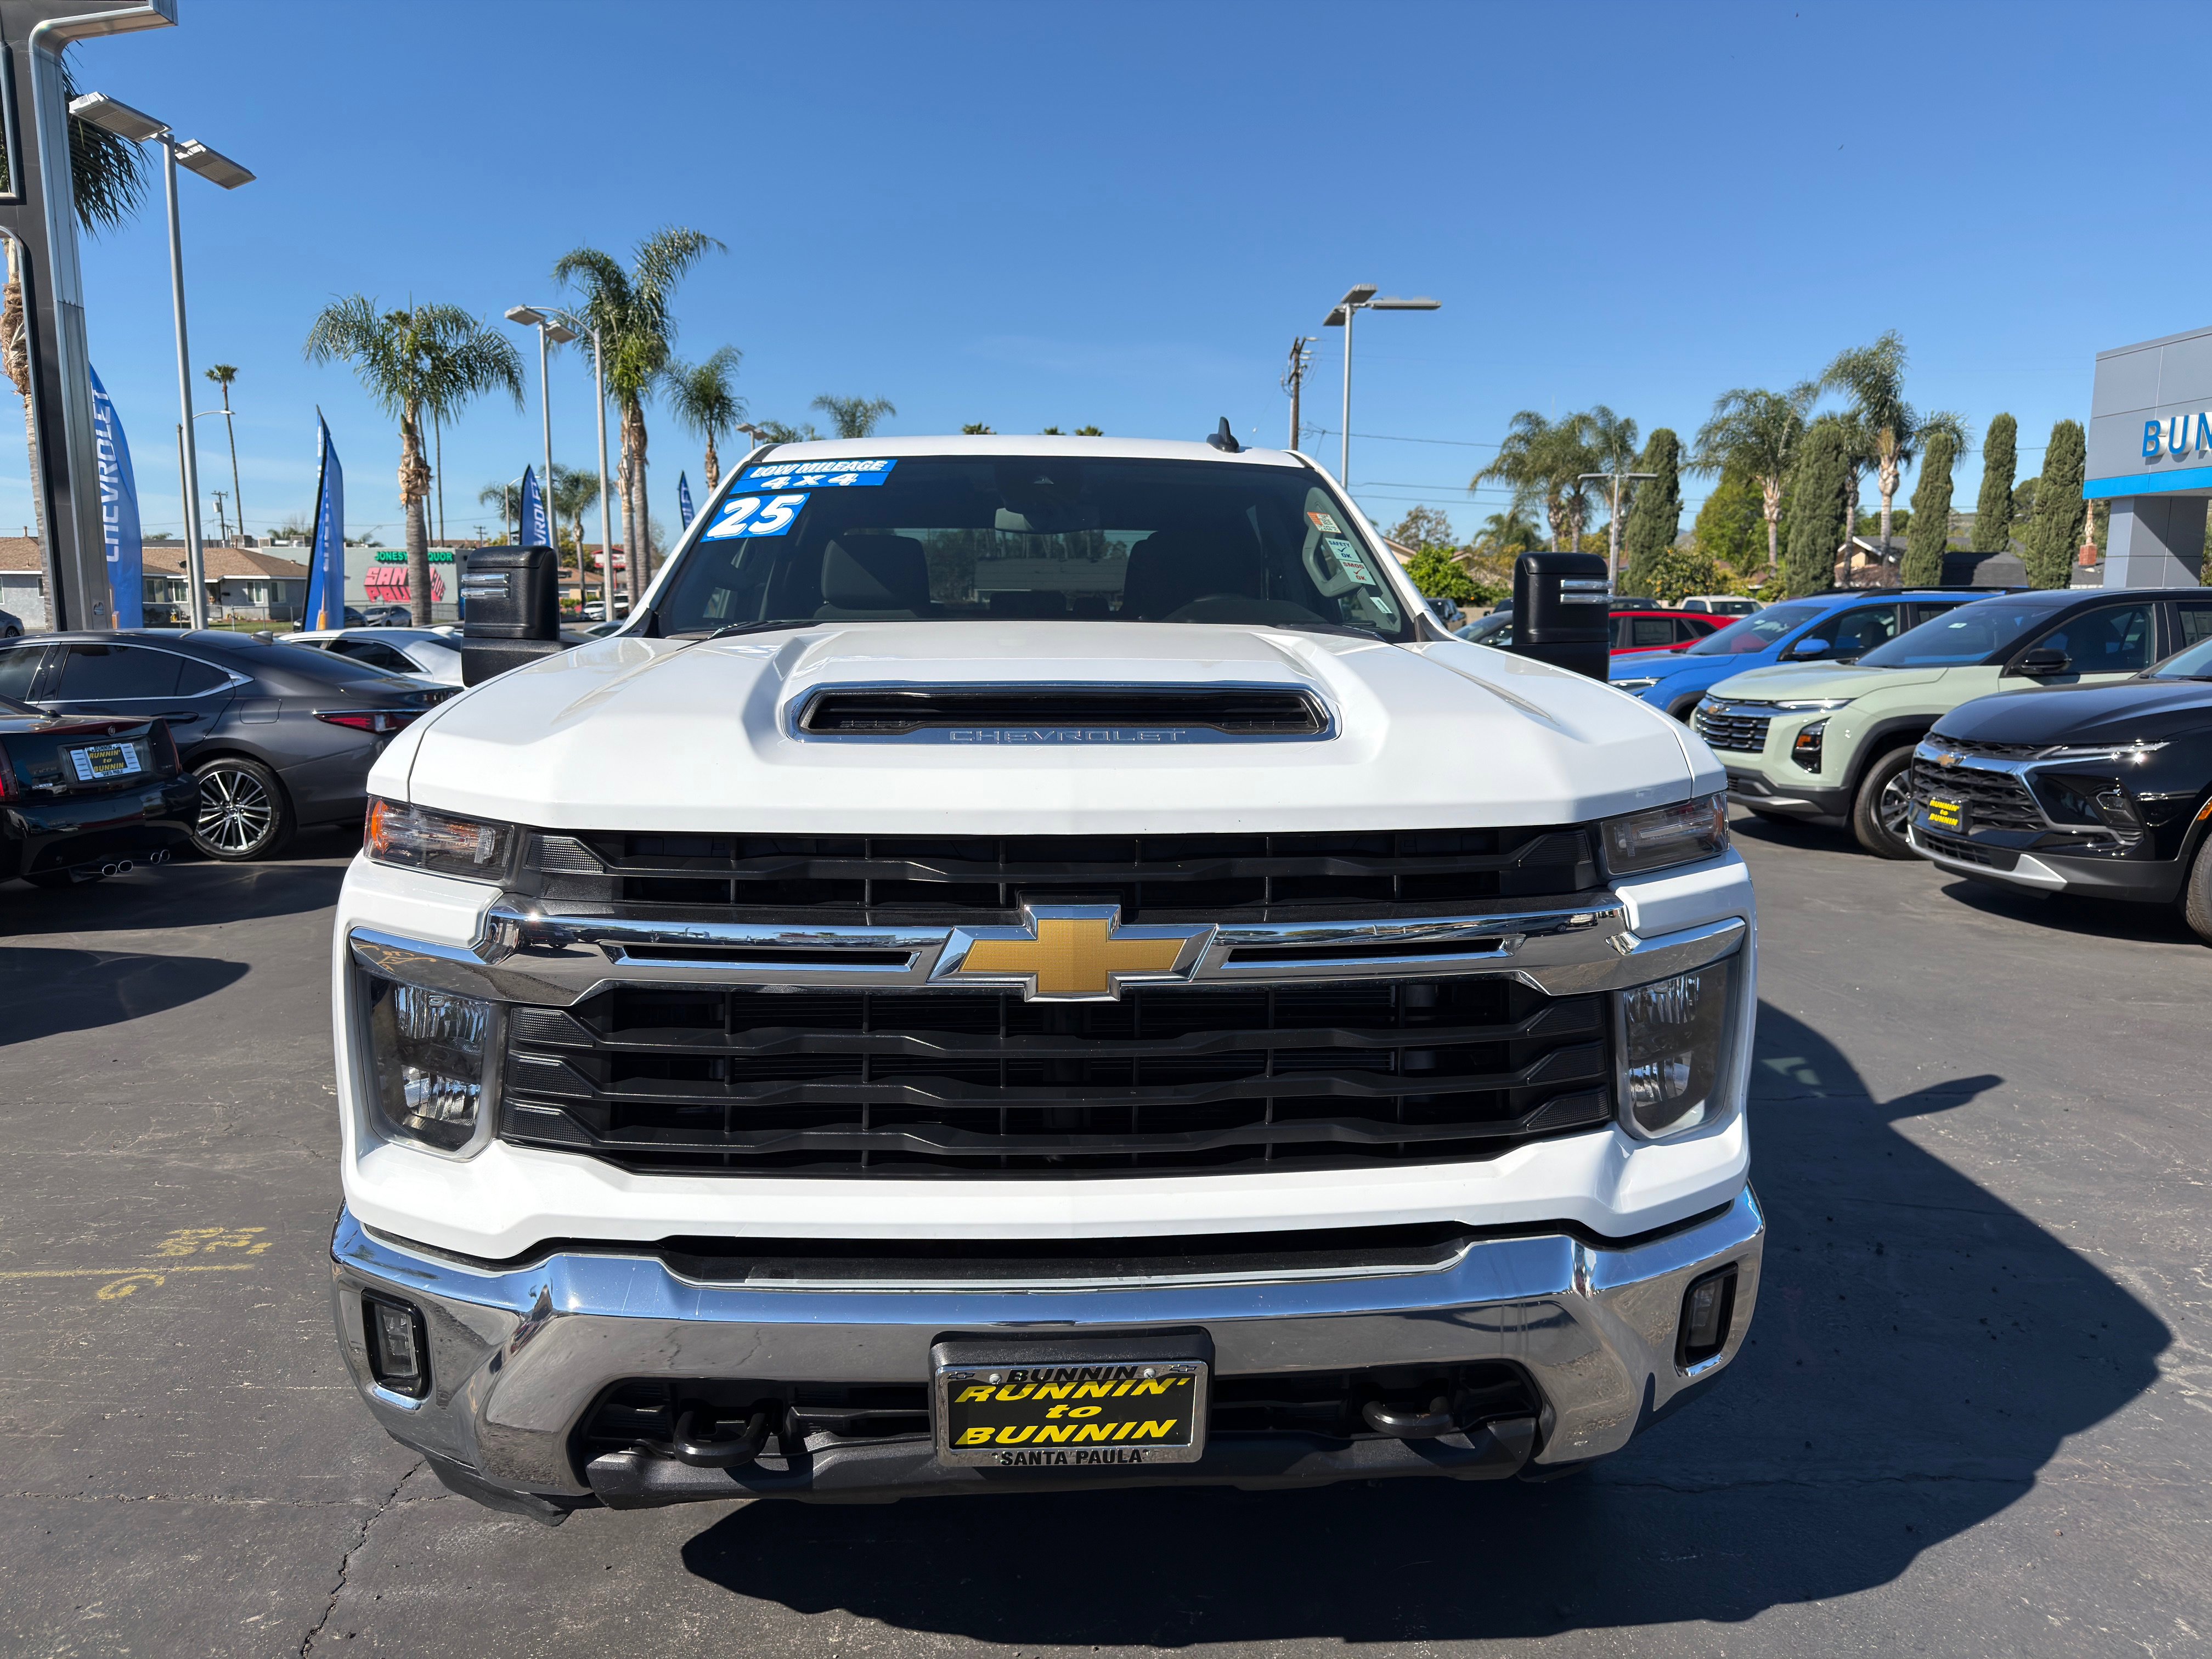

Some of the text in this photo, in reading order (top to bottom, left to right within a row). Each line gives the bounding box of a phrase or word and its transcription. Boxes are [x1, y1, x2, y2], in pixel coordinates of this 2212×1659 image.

[749, 460, 889, 478] LOW MILEAGE
[707, 495, 805, 538] 25
[428, 552, 453, 561] QUOR
[949, 731, 1186, 741] CHEVROLET
[89, 750, 121, 759] RUNNIN'
[94, 762, 124, 772] BUNNIN
[1929, 813, 1958, 826] BUNNIN
[1006, 1365, 1139, 1383] BUNNIN
[955, 1378, 1191, 1402] RUNNIN'
[1045, 1404, 1102, 1418] to
[955, 1419, 1178, 1444] BUNNIN
[1001, 1449, 1142, 1465] SANTA PAULA
